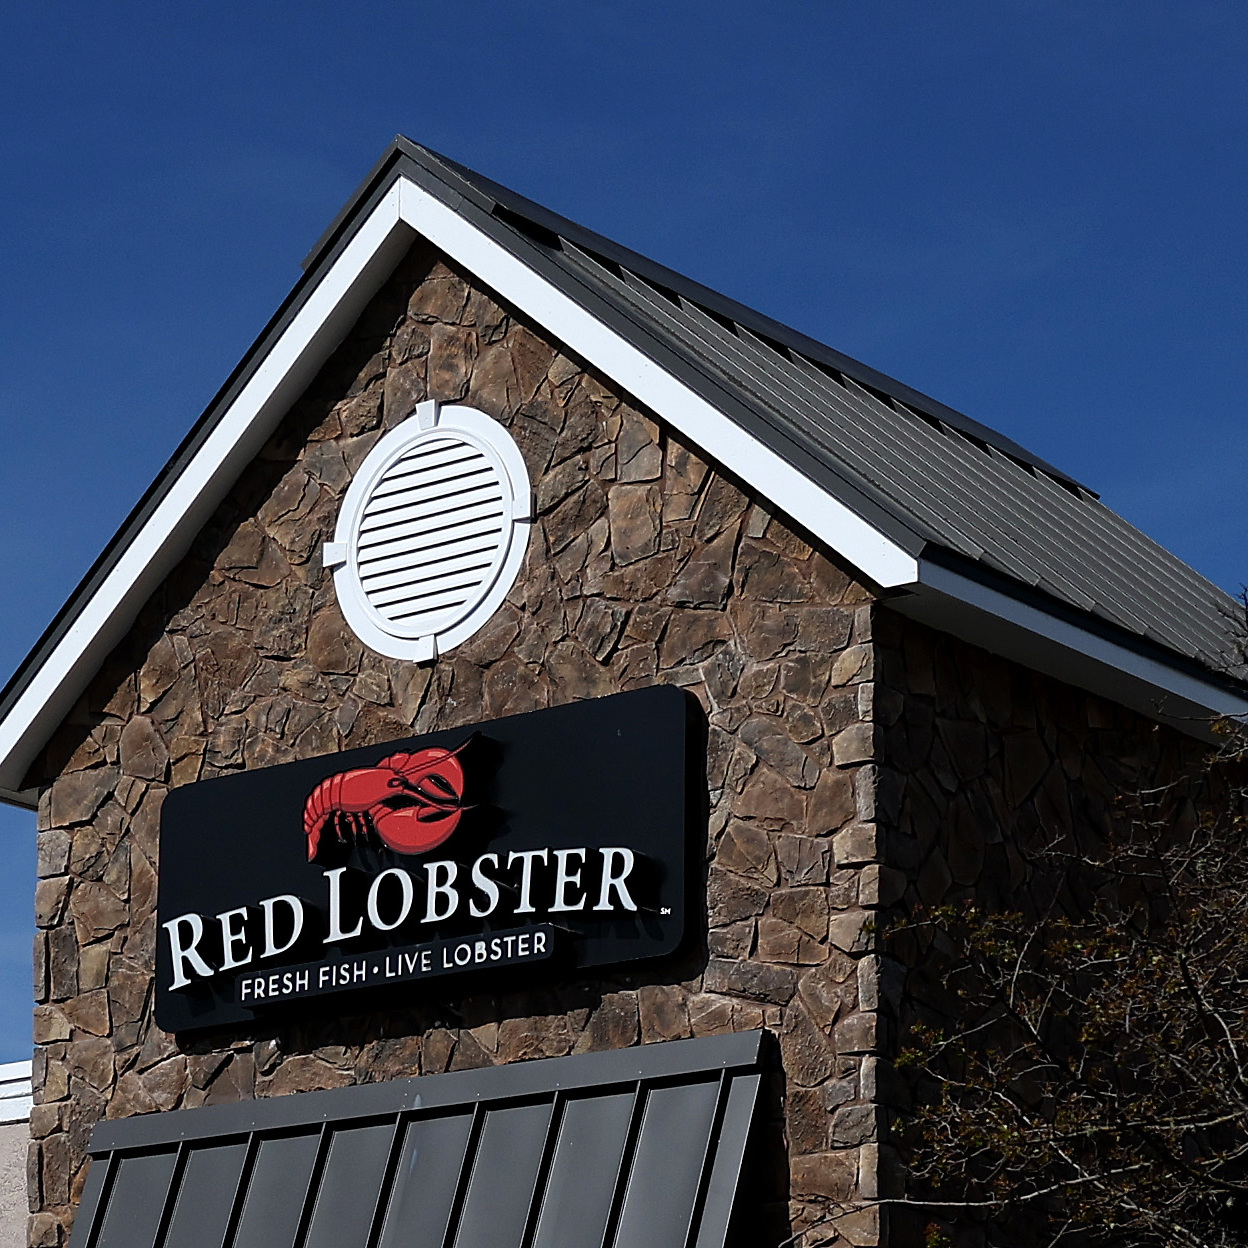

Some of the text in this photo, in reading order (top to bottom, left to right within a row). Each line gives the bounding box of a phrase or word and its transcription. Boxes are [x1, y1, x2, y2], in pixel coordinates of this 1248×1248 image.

[161, 847, 638, 992] RED LOBSTER
[240, 931, 548, 1002] FRESH FISH LIVE LOBSTER
